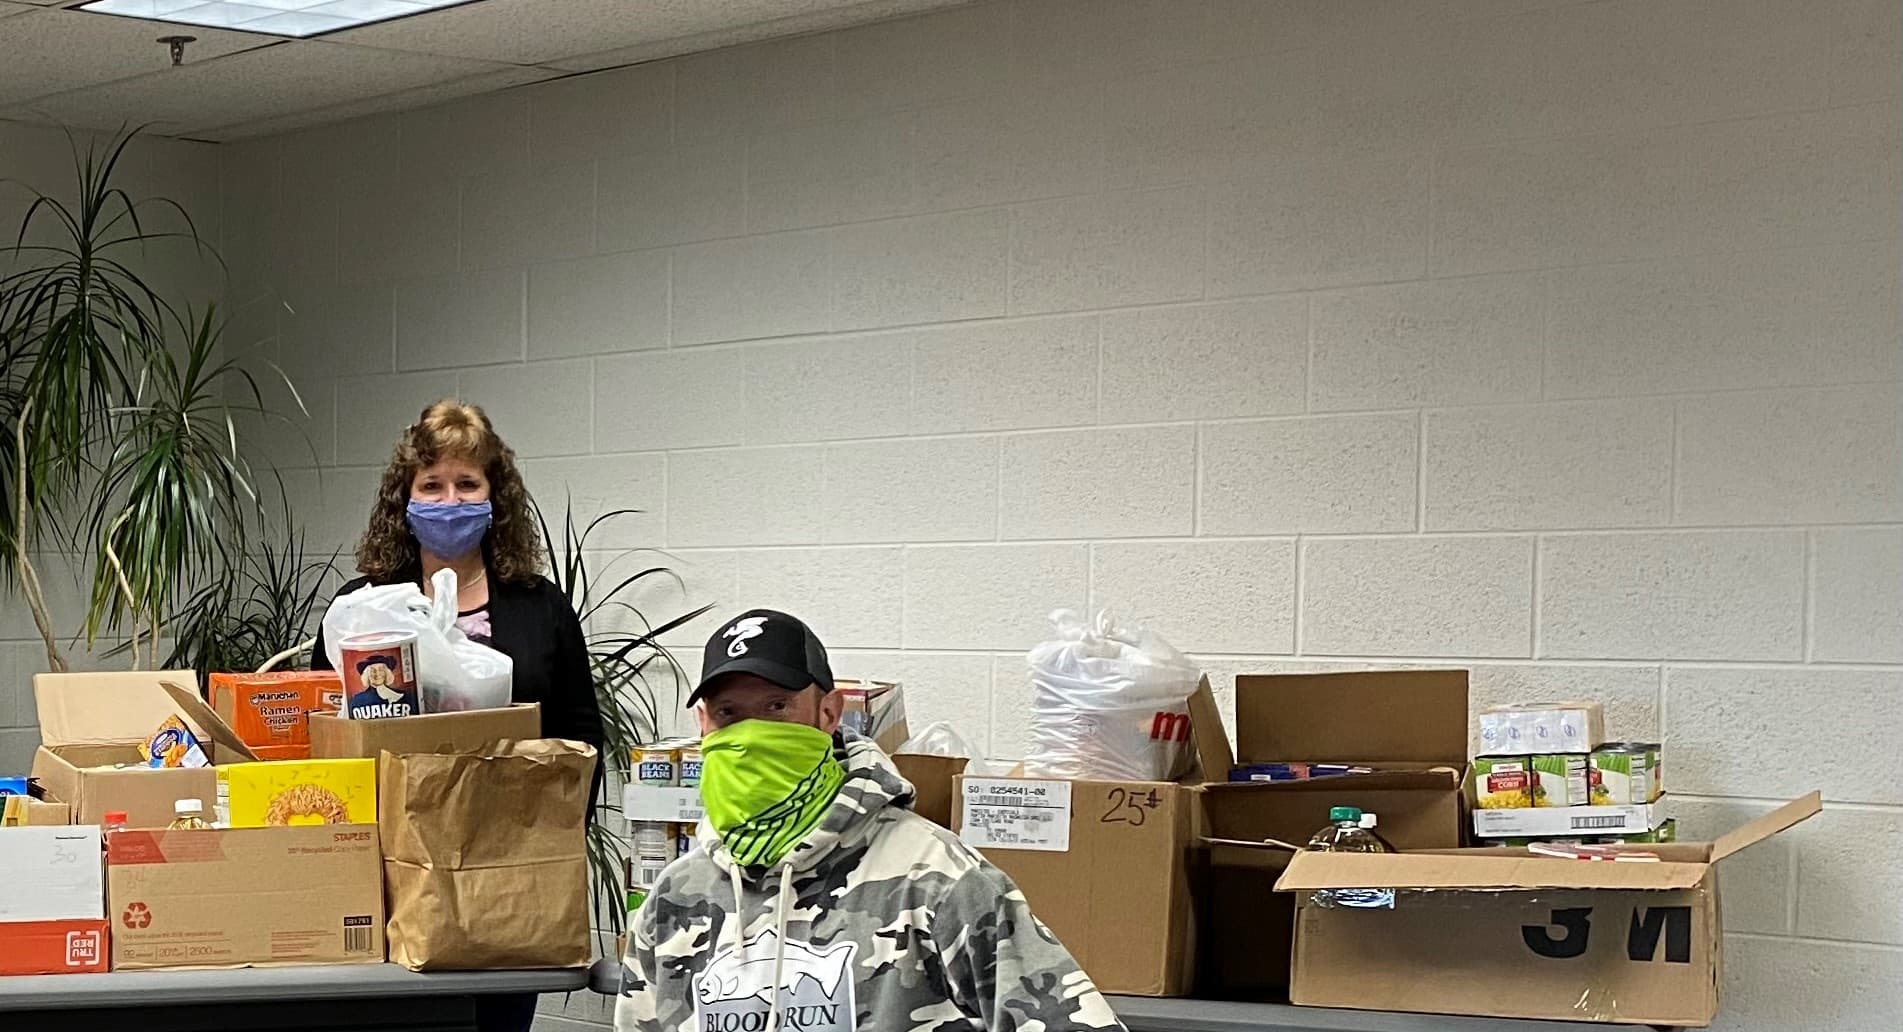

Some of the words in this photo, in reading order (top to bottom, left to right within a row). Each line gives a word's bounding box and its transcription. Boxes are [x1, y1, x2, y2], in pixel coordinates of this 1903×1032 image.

[260, 706, 300, 716] Ramen
[352, 703, 411, 719] QUAKER
[641, 763, 670, 772] BLACK
[641, 771, 670, 779] BEANS
[333, 832, 371, 842] STAPLES
